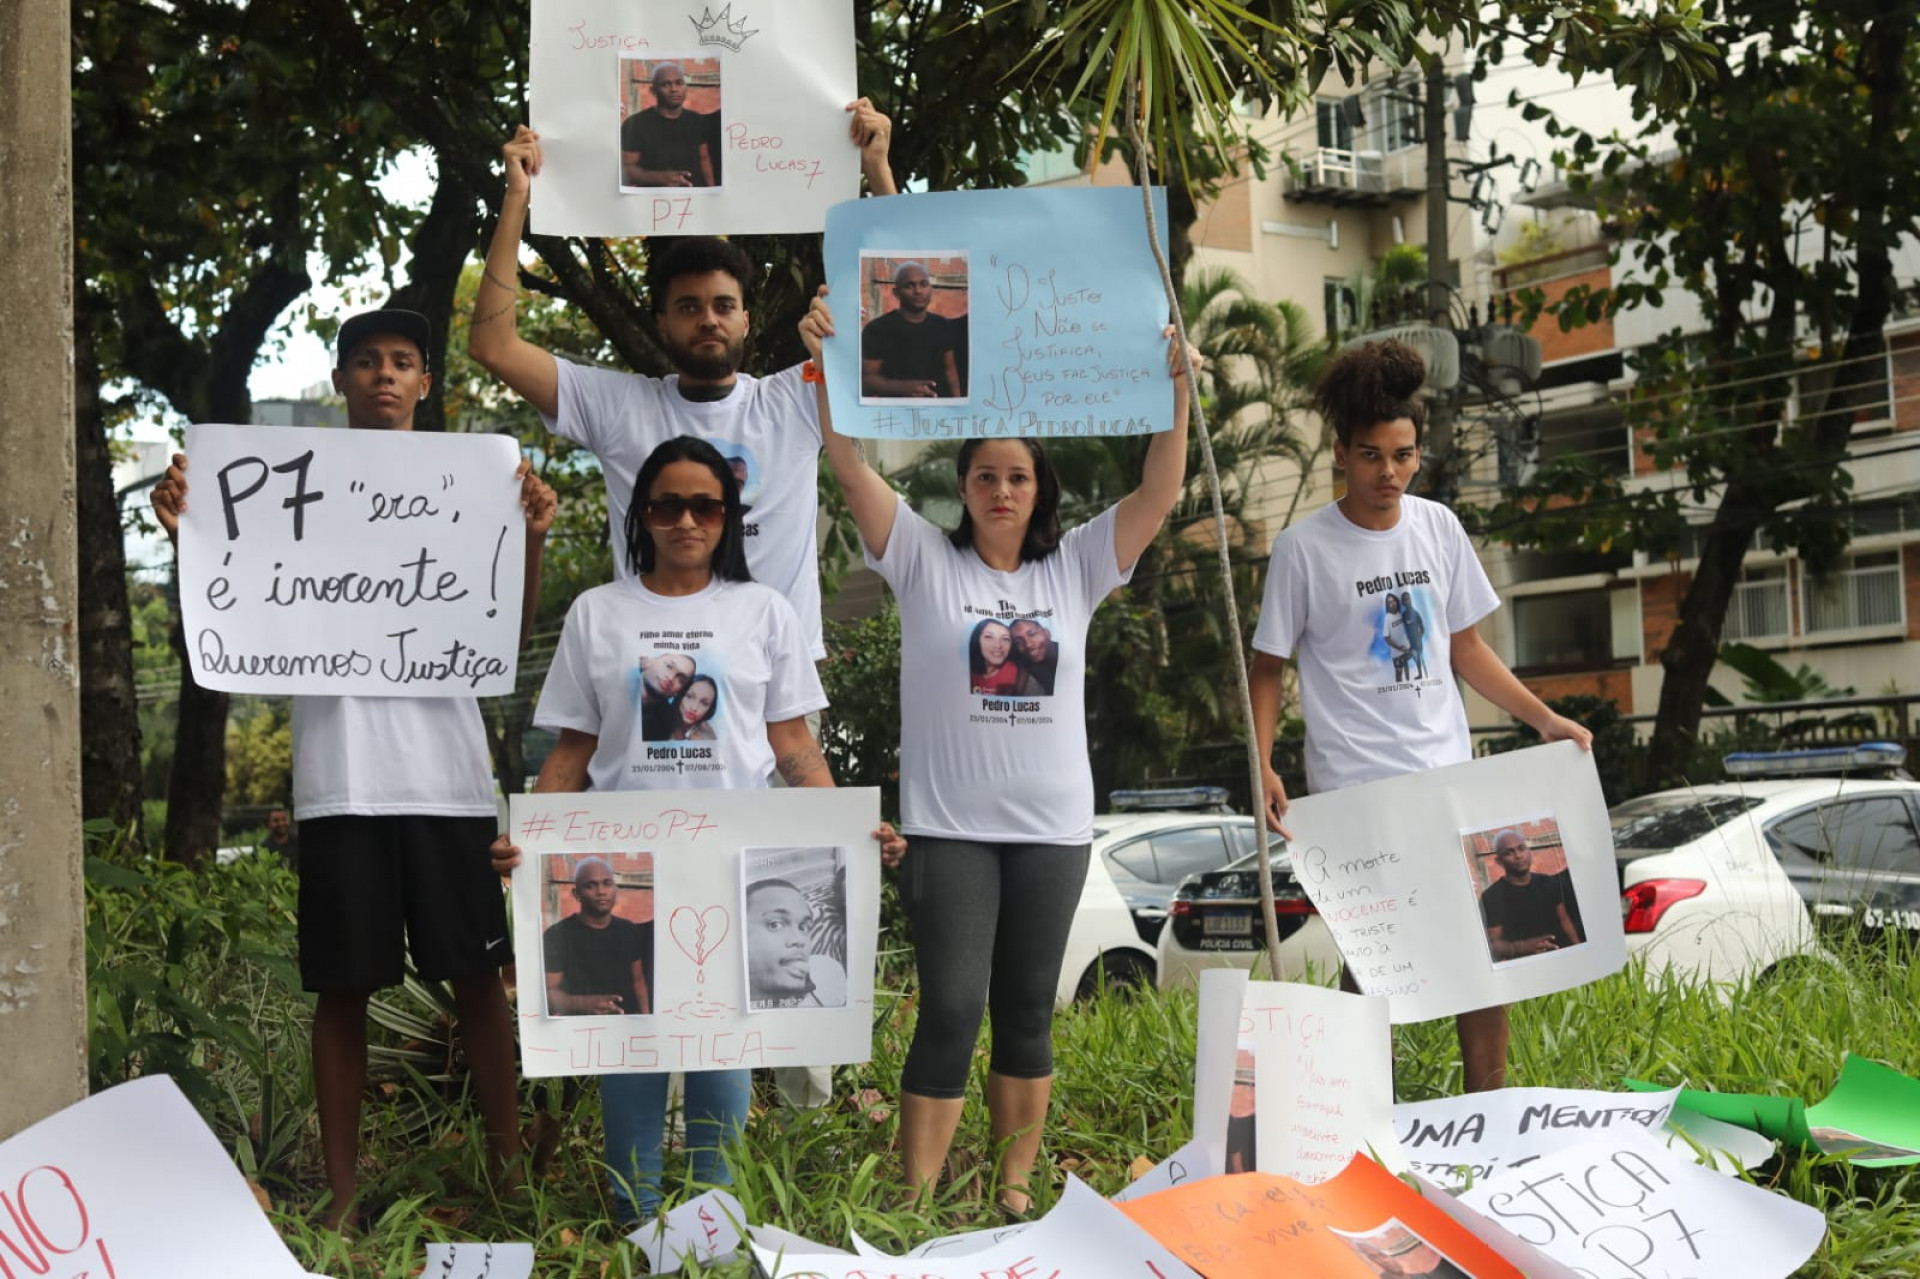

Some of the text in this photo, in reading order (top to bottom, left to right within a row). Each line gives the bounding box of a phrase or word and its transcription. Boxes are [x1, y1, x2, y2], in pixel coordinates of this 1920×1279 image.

[726, 123, 783, 150] PEDRO
[653, 198, 693, 231] P7
[217, 450, 324, 541] P7
[207, 552, 237, 611] é
[1356, 570, 1430, 598] Pedro Lucas
[199, 627, 508, 688] Queremos Justiça
[982, 699, 1041, 712] Pedro Lucas
[647, 746, 712, 759] Pedro Lucas
